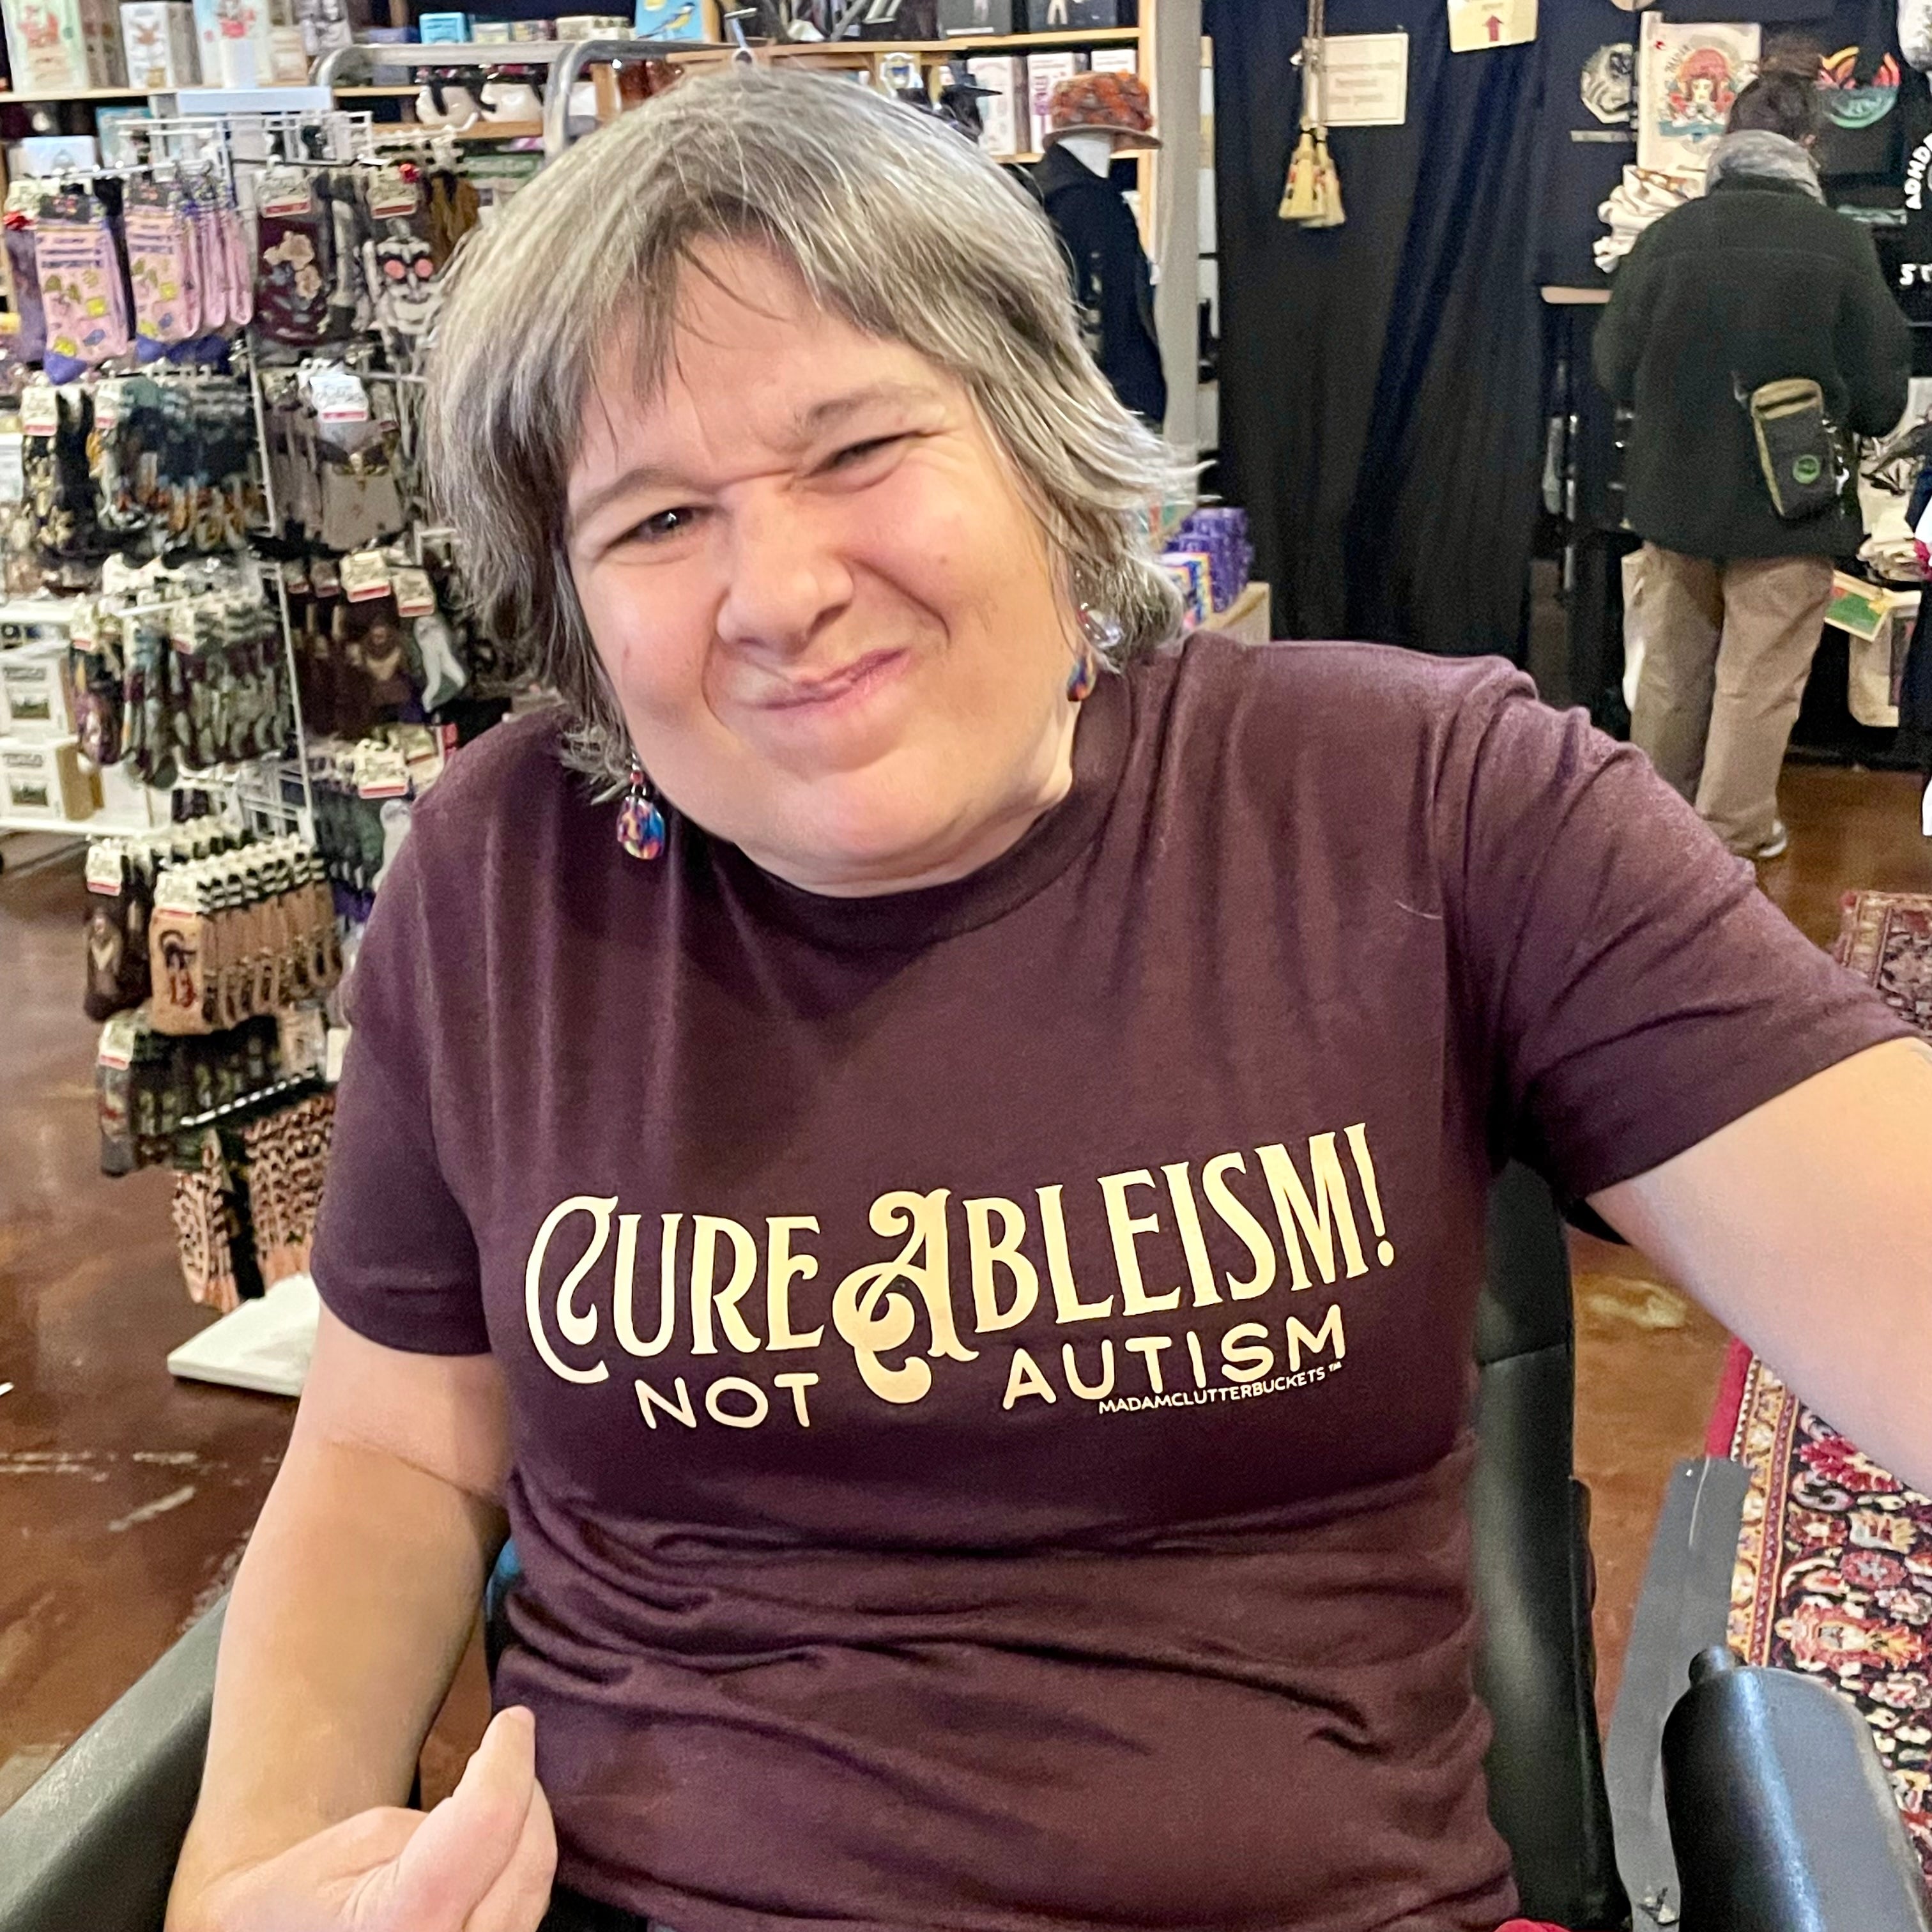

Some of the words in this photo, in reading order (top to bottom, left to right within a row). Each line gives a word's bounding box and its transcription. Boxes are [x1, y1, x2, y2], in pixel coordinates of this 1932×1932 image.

[525, 1195, 825, 1384] CURE
[832, 1123, 1394, 1404] ABLEISM!
[634, 1373, 819, 1429] NOT
[1002, 1304, 1346, 1410] AUTISM
[1098, 1367, 1326, 1414] MADAMCLUTTERBUCKETS
